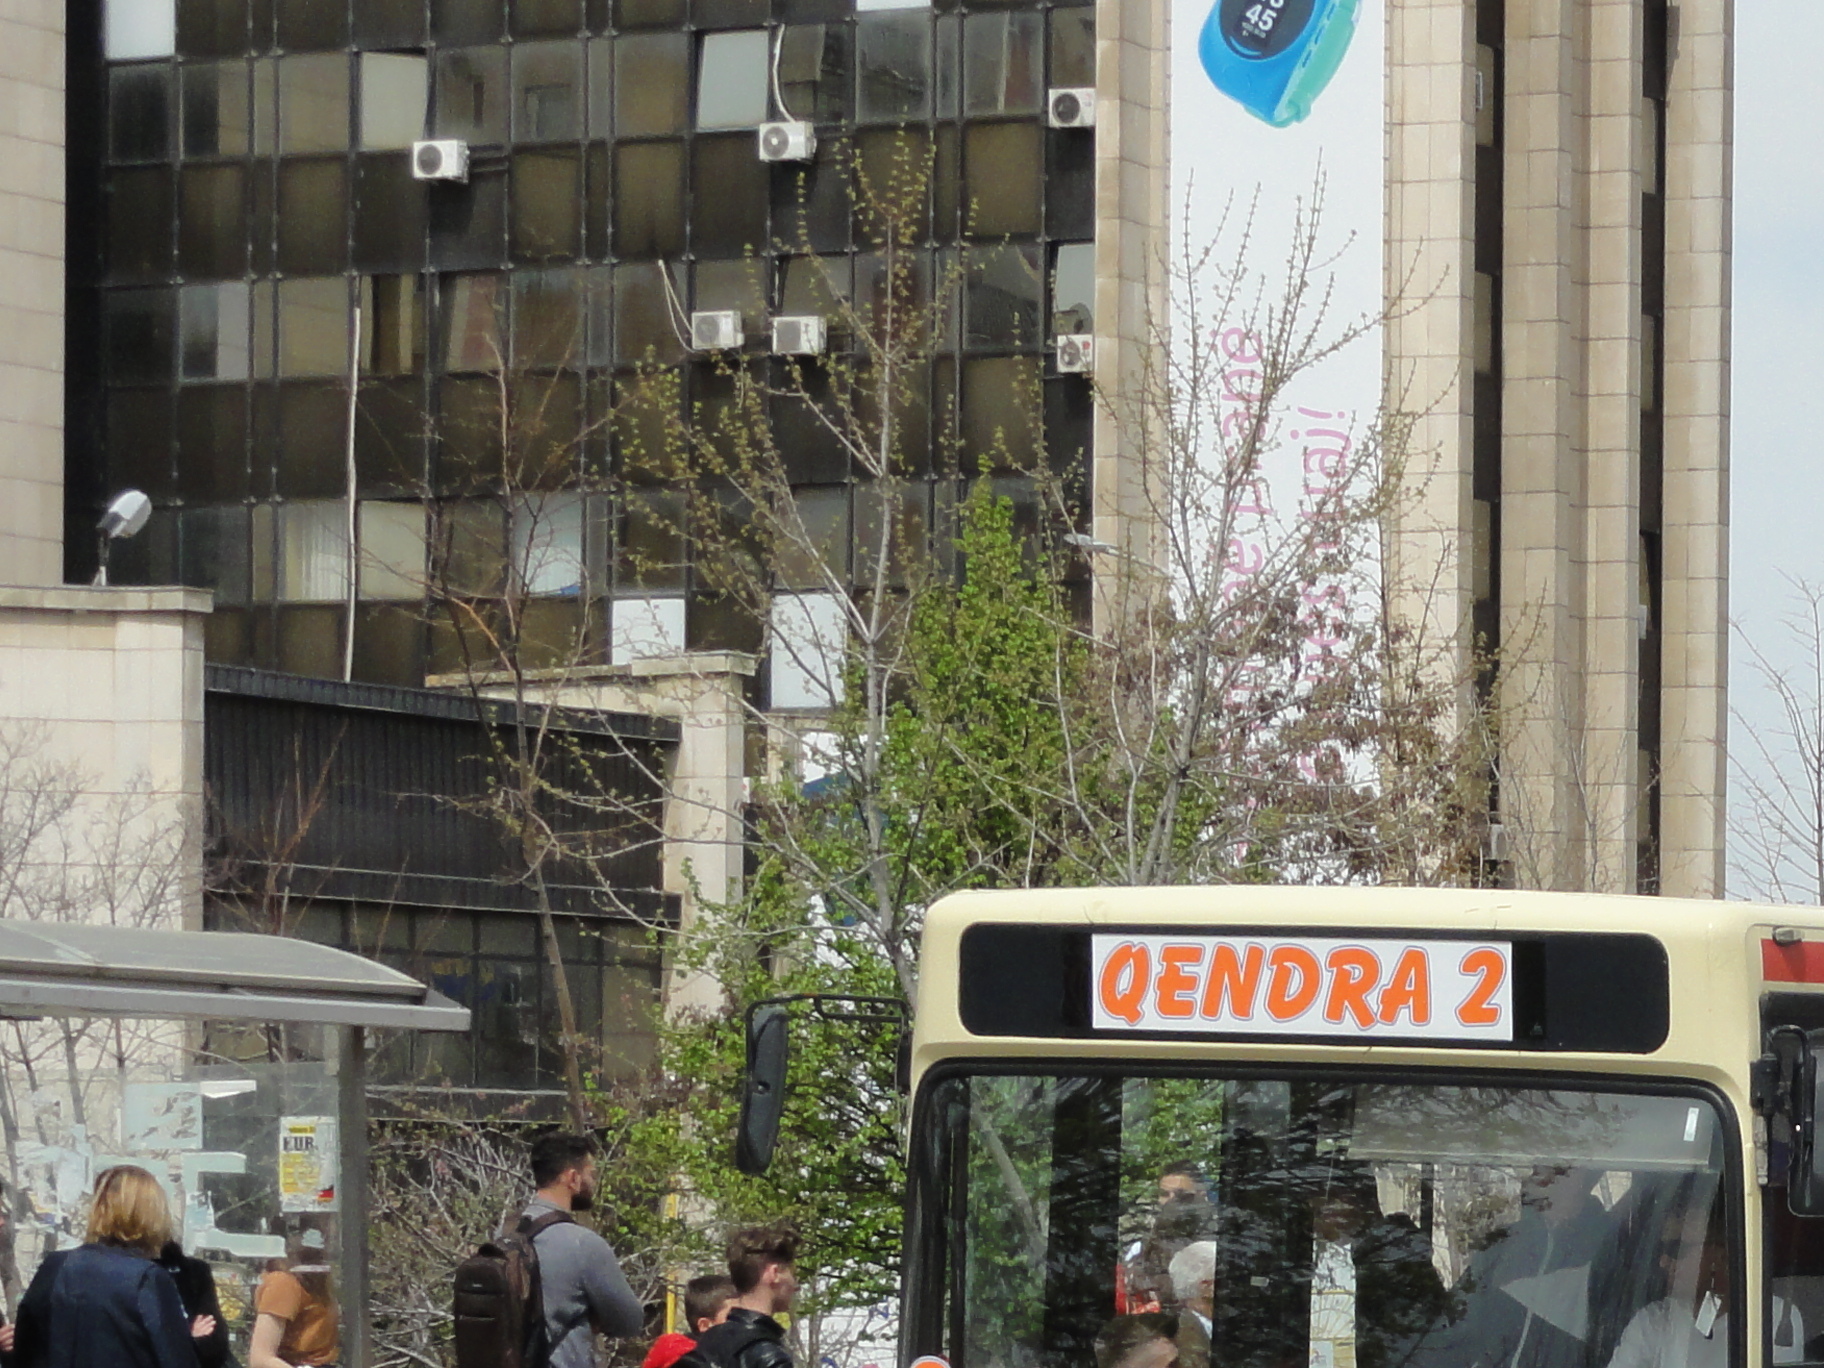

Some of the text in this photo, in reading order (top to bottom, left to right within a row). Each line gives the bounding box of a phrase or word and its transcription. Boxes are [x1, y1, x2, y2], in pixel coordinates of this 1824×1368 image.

[1245, 4, 1277, 30] 45
[1099, 941, 1506, 1030] QENDRA 2
